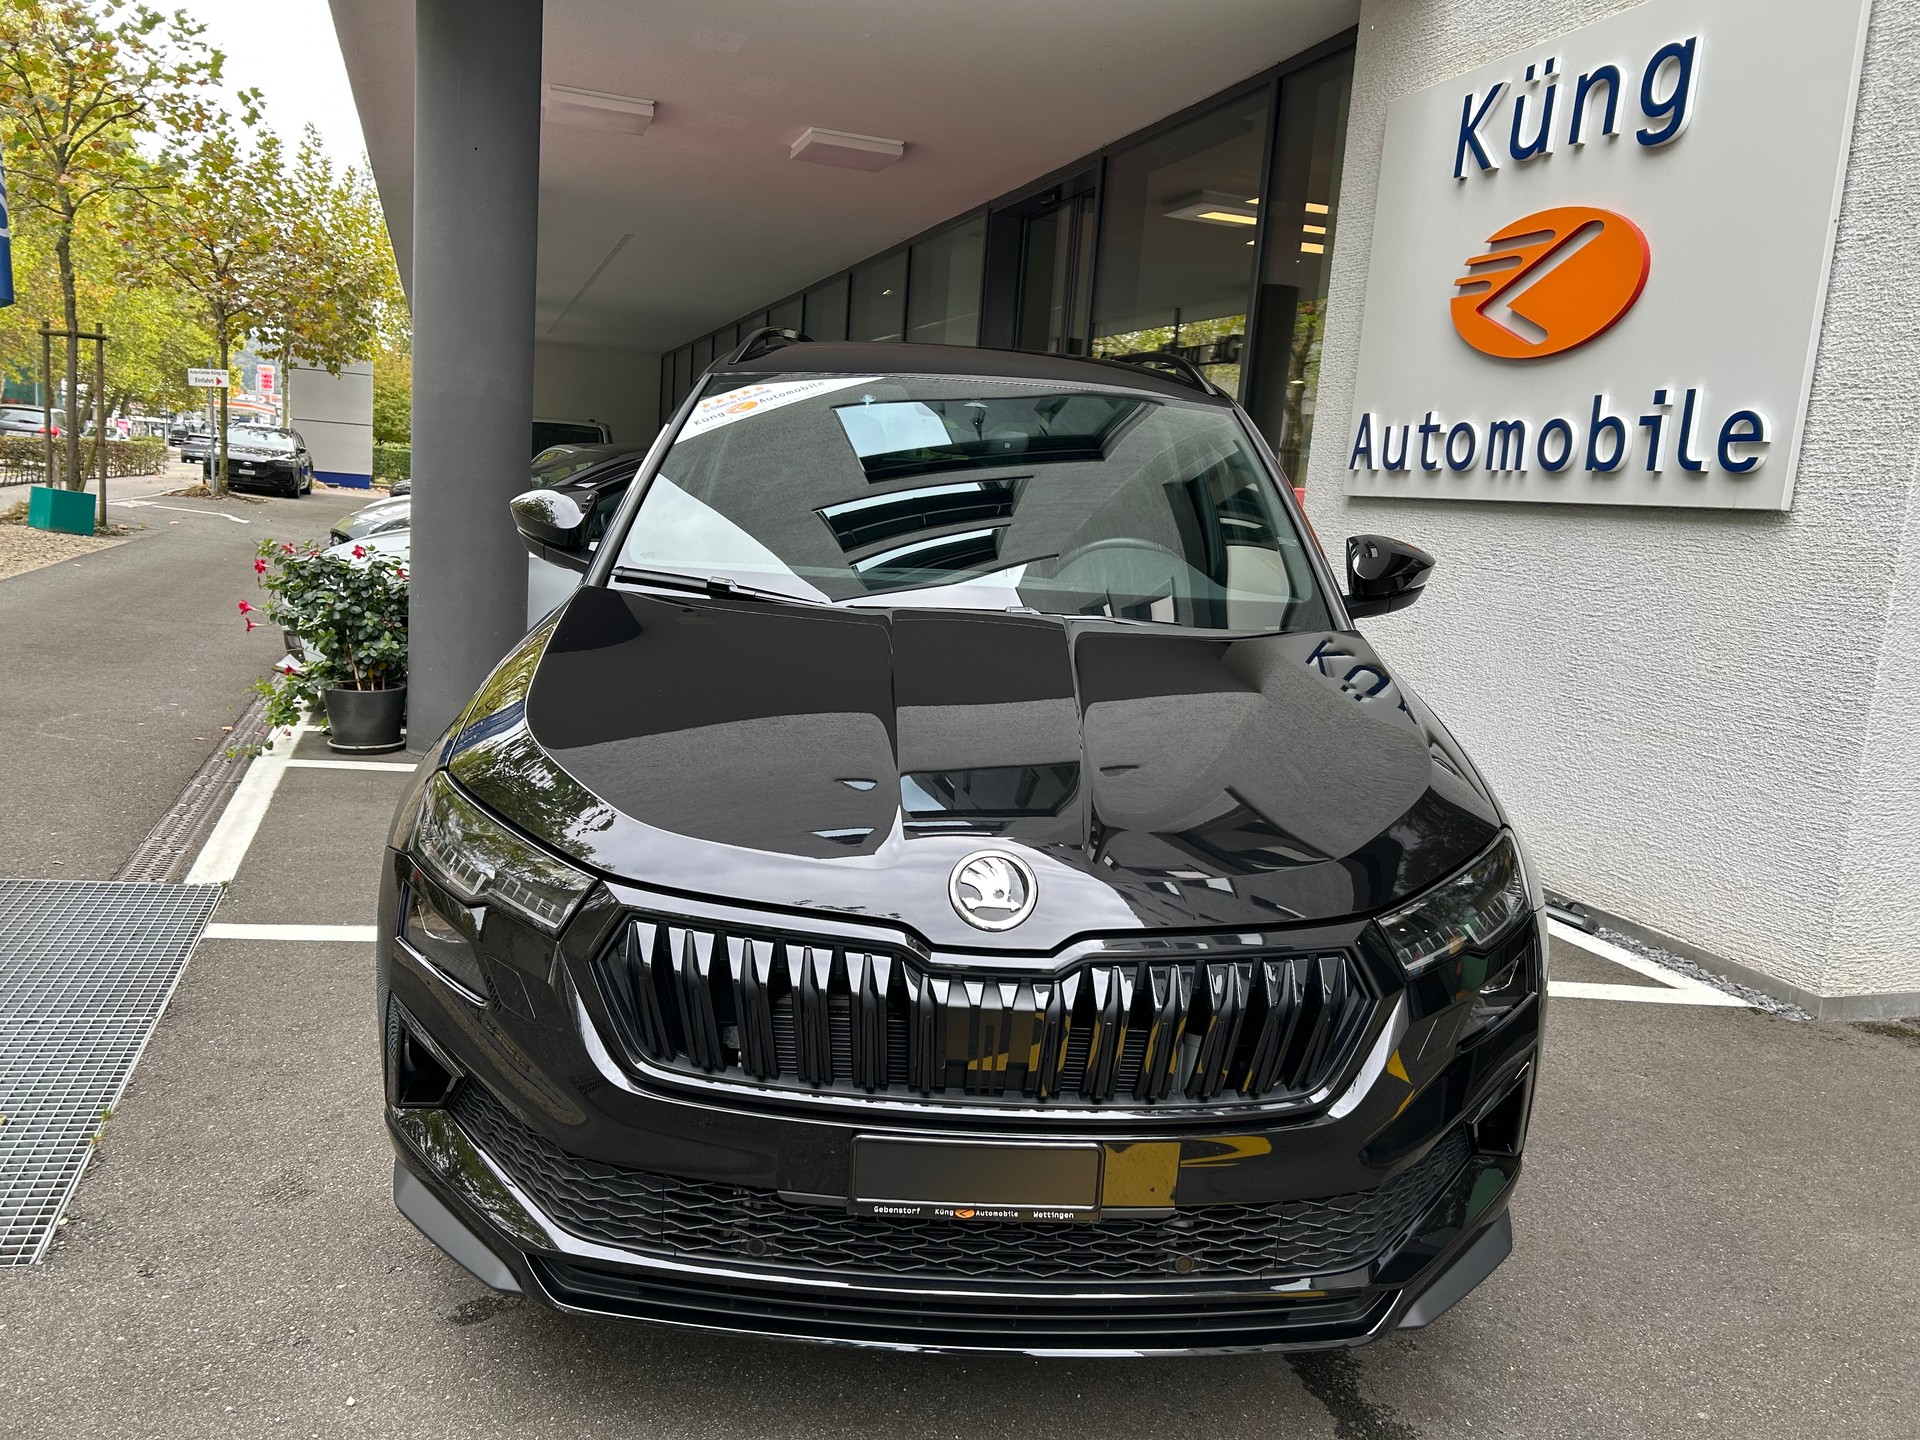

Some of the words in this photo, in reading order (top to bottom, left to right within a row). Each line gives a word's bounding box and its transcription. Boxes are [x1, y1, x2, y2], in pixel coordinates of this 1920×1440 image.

[1453, 36, 1701, 180] Küng
[693, 412, 725, 426] Küng
[760, 381, 825, 403] Automobile
[1349, 387, 1771, 474] Automobile
[873, 1205, 921, 1215] Gebenstorf
[934, 1208, 954, 1217] Küng
[975, 1210, 1019, 1218] Automobile
[1033, 1211, 1074, 1220] Wettingen
